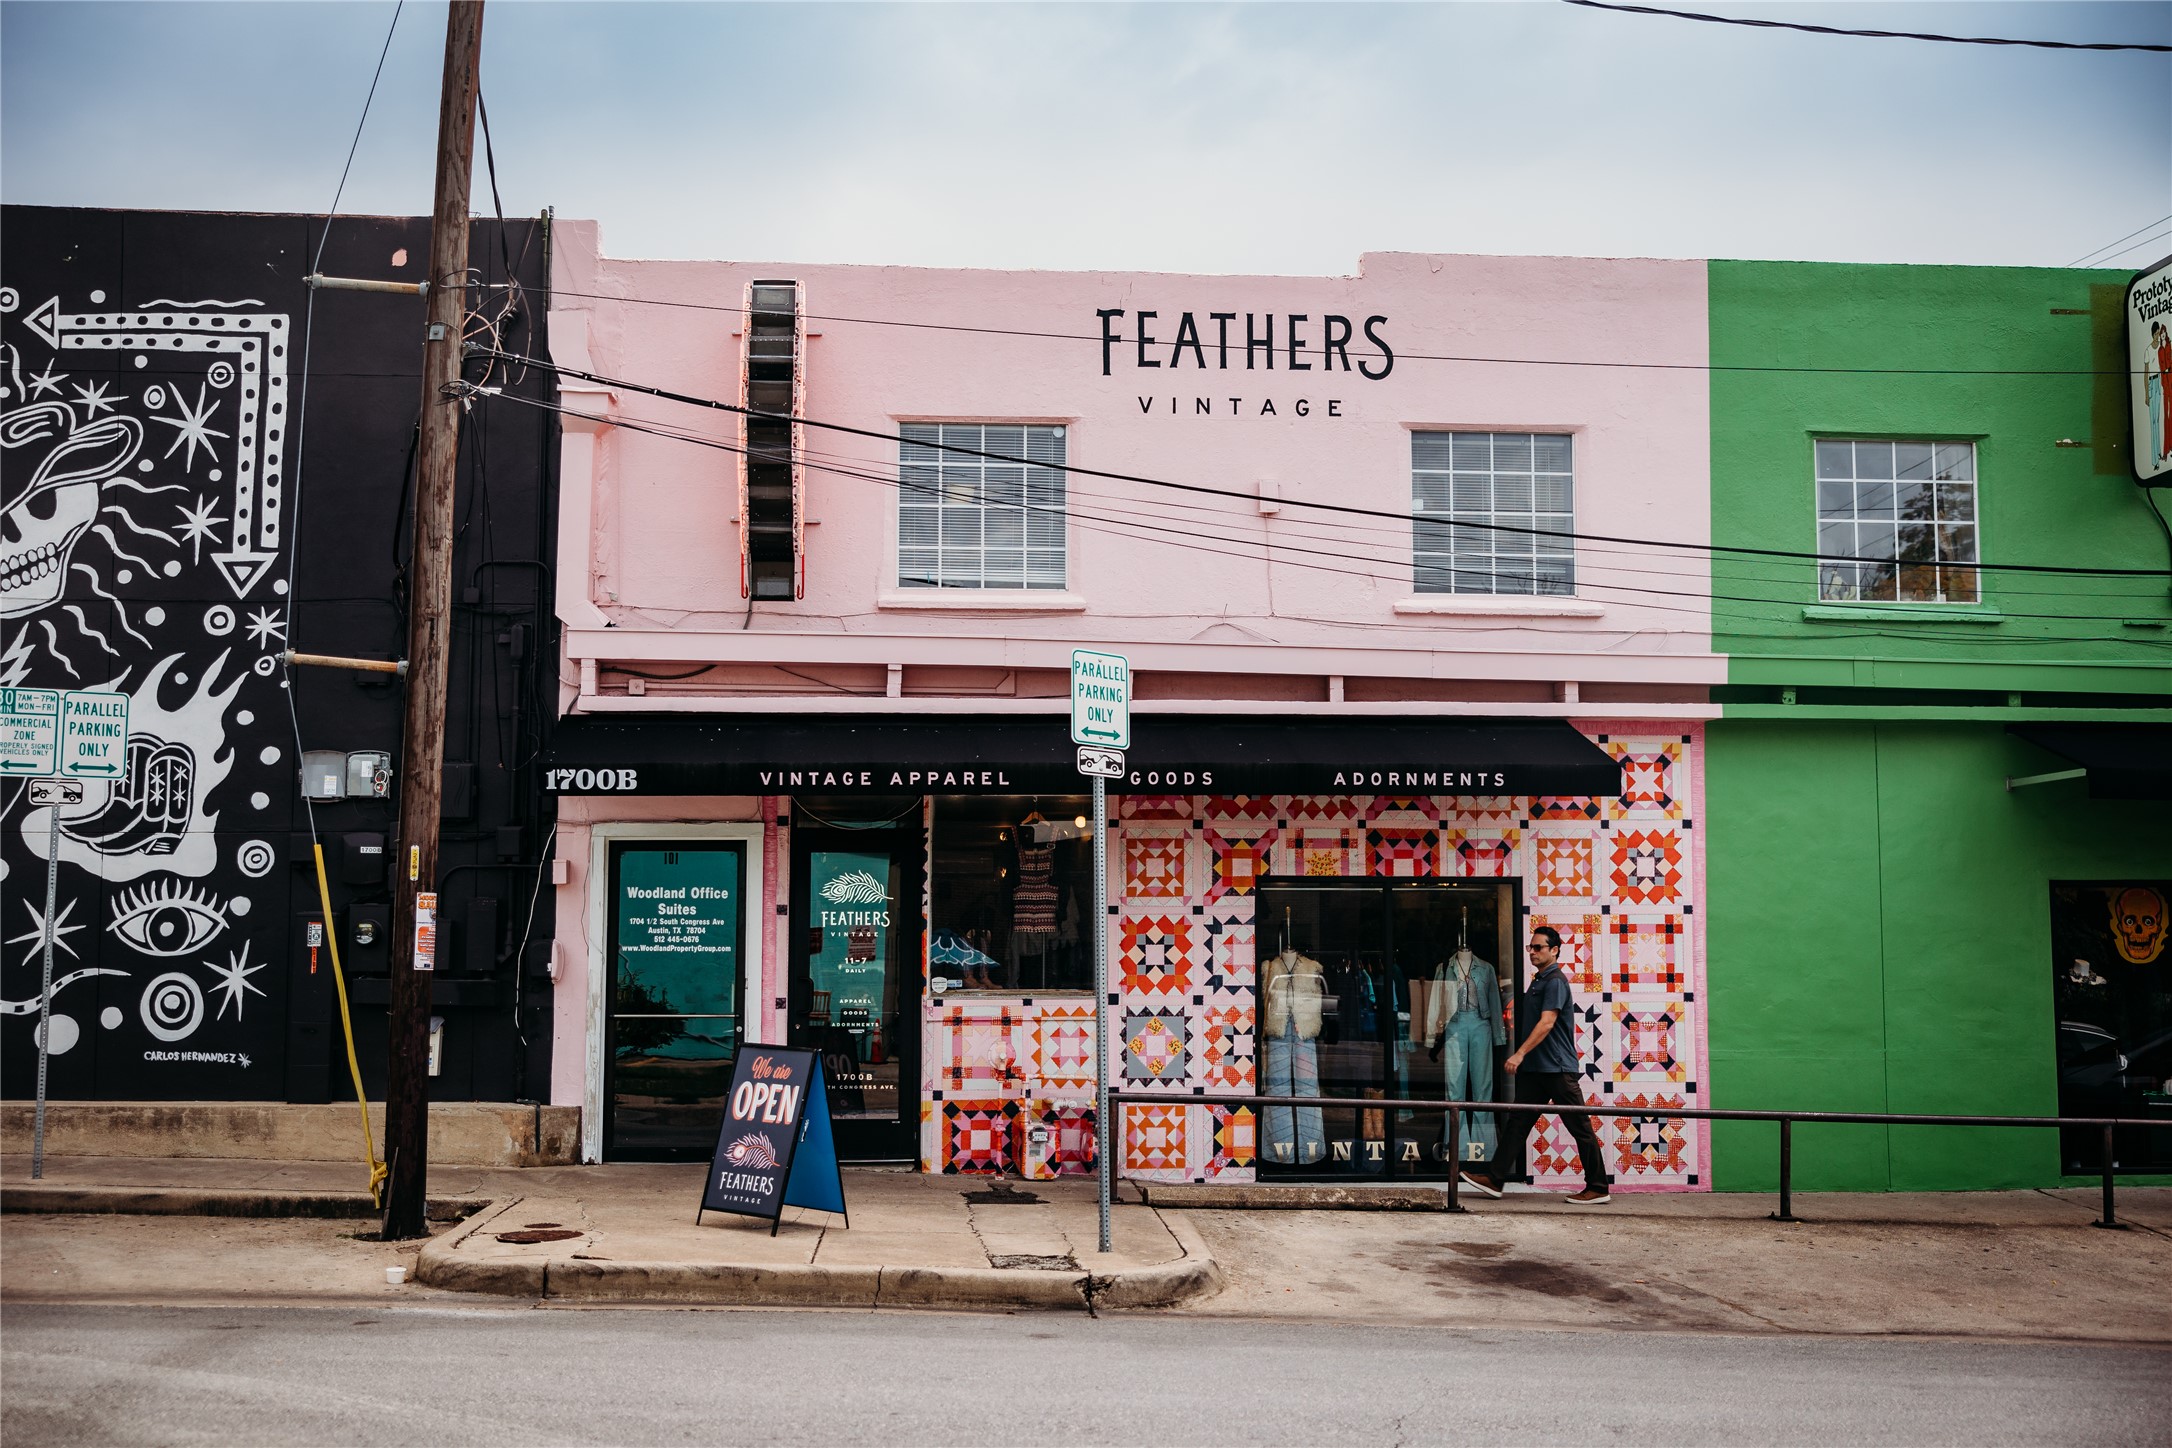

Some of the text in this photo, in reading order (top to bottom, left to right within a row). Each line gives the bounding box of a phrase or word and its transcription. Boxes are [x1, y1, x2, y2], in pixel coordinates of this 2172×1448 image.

[1096, 308, 1394, 380] FEATHERS
[1138, 397, 1342, 417] VINTAGE
[1075, 660, 1125, 682] PARALLEL
[1079, 683, 1123, 703] PARKING
[66, 701, 126, 718] PARALLEL
[1088, 706, 1113, 723] ONLY
[14, 730, 36, 740] ZONE
[69, 721, 121, 737] PARKING
[79, 742, 109, 757] ONLY
[546, 769, 637, 790] 1700B
[760, 772, 1010, 786] VINTAGE APPAREL
[1130, 771, 1213, 786] GOODS
[1333, 772, 1505, 787] ADORNMENTS
[627, 886, 729, 899] Woodland Office
[658, 903, 697, 915] Suites
[629, 917, 645, 925] 1704
[646, 917, 658, 925] 1/2
[659, 917, 679, 925] South
[680, 917, 710, 926] Congress
[821, 911, 891, 928] FEATHERS
[648, 926, 706, 935] Austin, TX 78704
[653, 935, 666, 943] 512
[621, 944, 732, 953] www.WoodlandPropertyGroup.com
[143, 1051, 237, 1064] CARLOS HERNANDEZ
[752, 1056, 773, 1080] We
[836, 1073, 873, 1081] 1700B
[732, 1080, 800, 1125] OPEN
[719, 1171, 775, 1195] FEATHERS
[723, 1194, 762, 1205] VINTAGE
